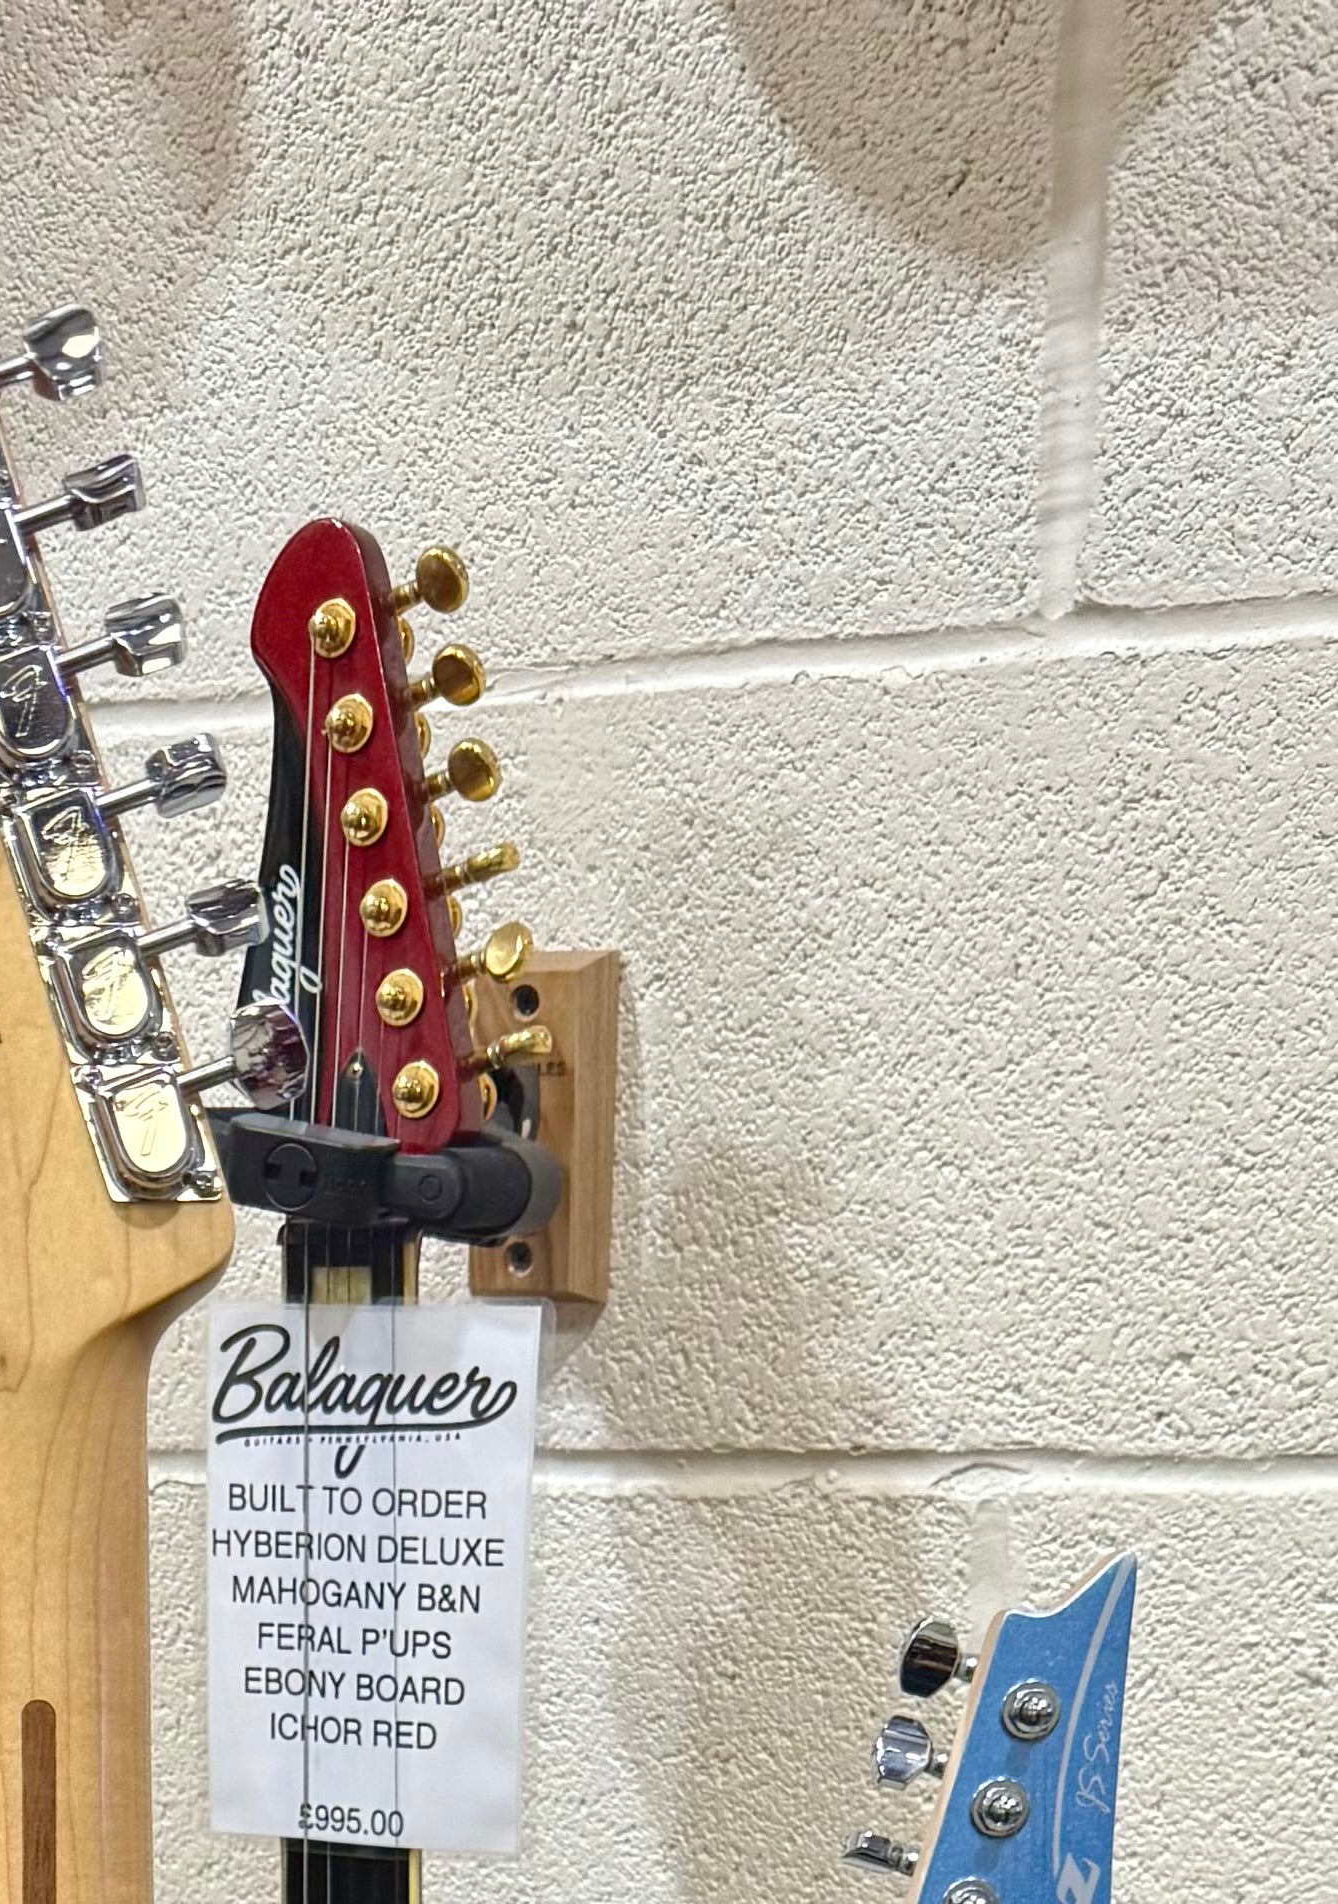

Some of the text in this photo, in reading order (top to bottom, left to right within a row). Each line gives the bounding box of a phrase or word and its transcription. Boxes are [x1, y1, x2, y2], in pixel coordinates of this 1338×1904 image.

[211, 1323, 518, 1479] Balaguer
[322, 1486, 362, 1515] TO
[372, 1488, 487, 1519] ORDER
[212, 1529, 504, 1567] HYBERION DELUXE
[232, 1575, 480, 1614] MAHOGANY B&N
[258, 1622, 452, 1660] FERAL P’UPS
[245, 1667, 465, 1706] EBONY BOARD
[271, 1712, 437, 1750] ICHOR RED
[298, 1802, 404, 1837] £995.00
